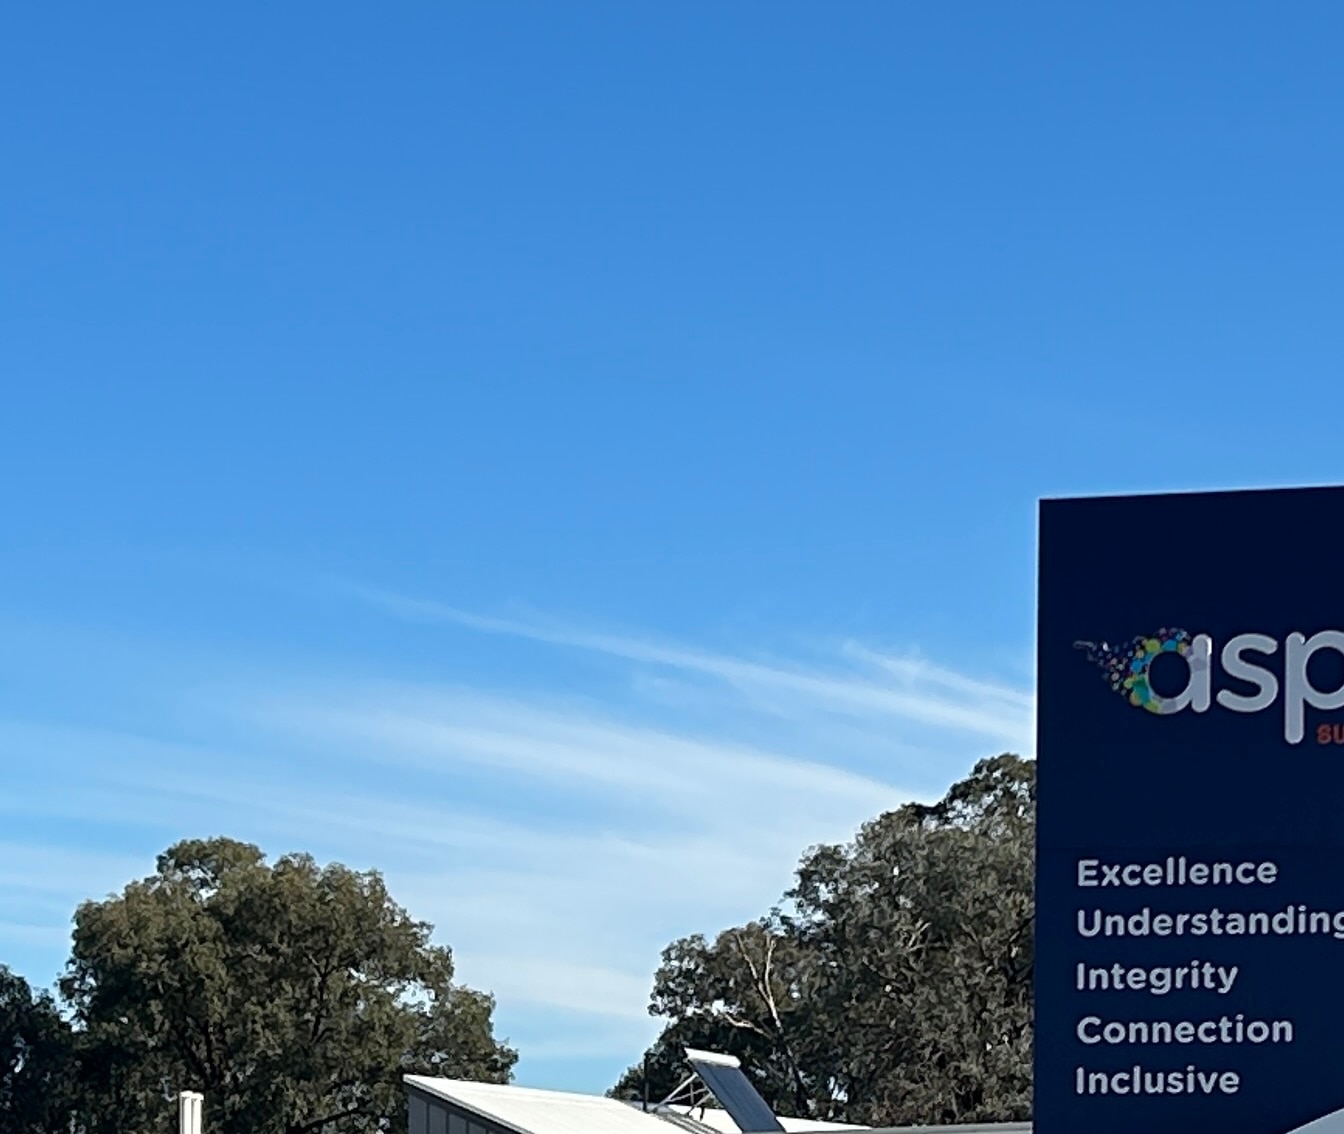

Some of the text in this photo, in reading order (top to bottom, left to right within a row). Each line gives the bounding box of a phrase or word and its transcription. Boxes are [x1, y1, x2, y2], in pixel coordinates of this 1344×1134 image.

[1076, 856, 1279, 888] Excellence
[1076, 959, 1239, 995] Integrity
[1076, 1013, 1294, 1044] Connection
[1076, 1065, 1241, 1095] Inclusive
